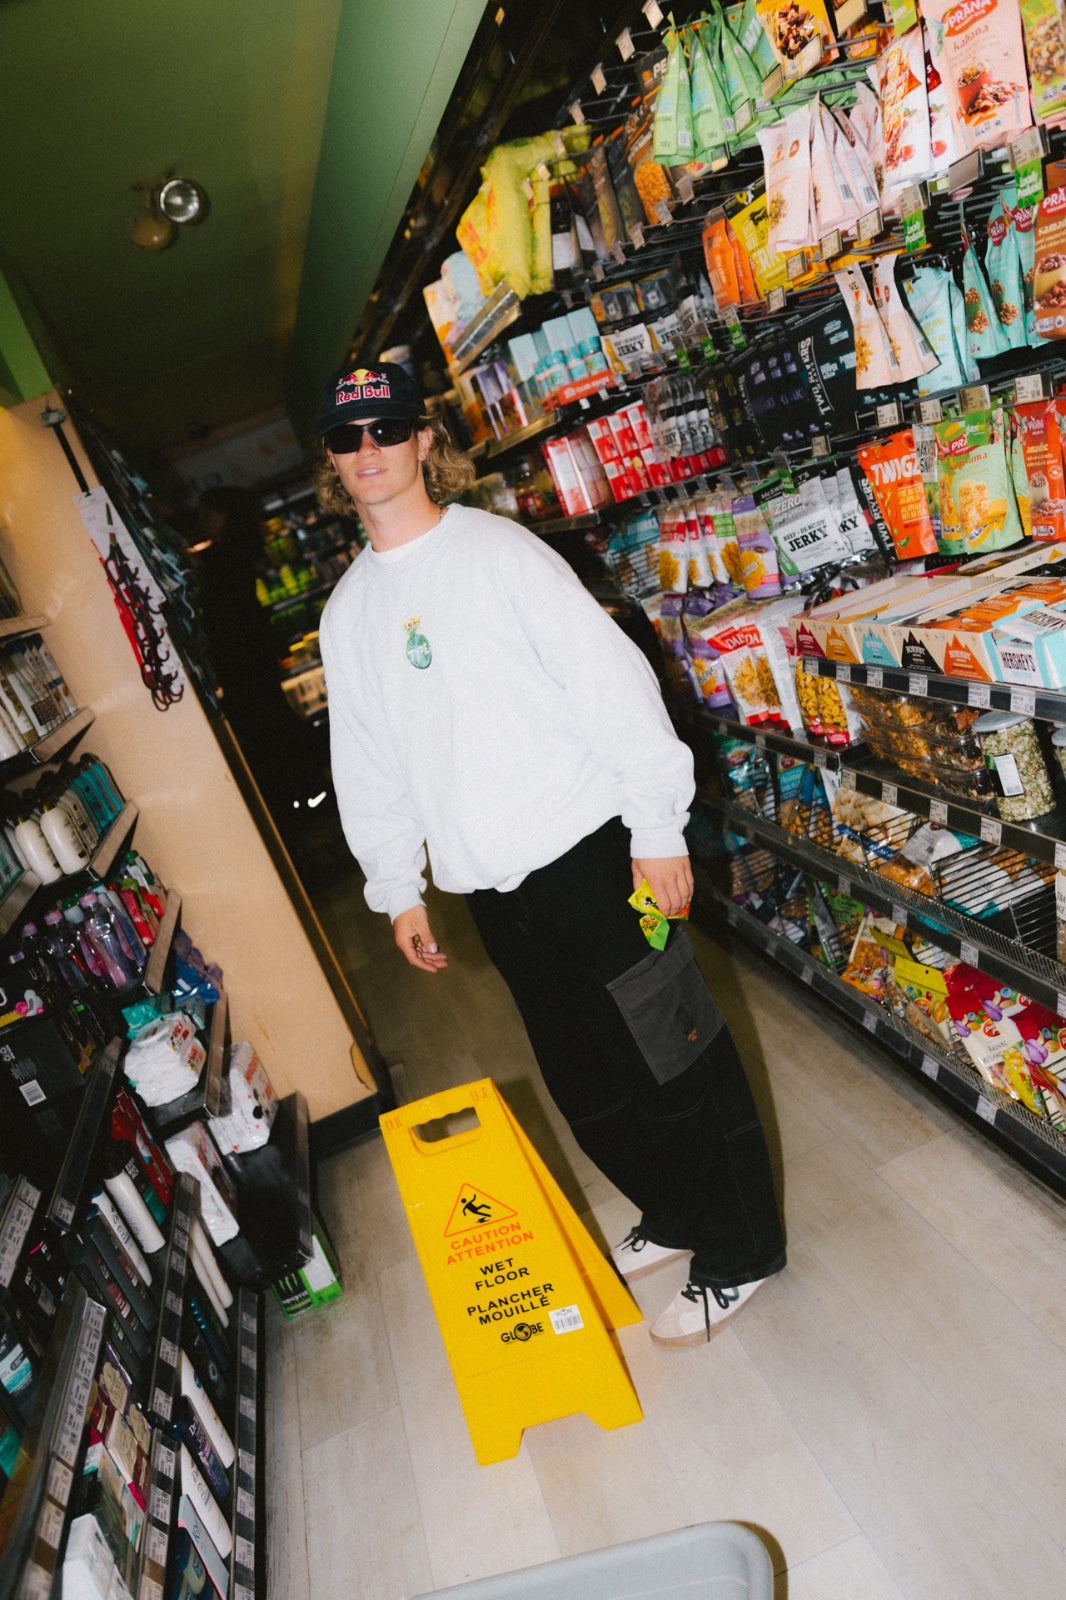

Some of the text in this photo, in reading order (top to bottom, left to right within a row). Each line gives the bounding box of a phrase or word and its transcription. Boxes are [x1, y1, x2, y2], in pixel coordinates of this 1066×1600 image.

[336, 385, 391, 406] Red Bull
[774, 494, 801, 515] ZERO
[788, 525, 829, 552] JERKY
[877, 523, 894, 551] TWO
[1001, 651, 1036, 672] HERSHEY'S
[447, 1231, 534, 1265] ATTENTION
[450, 1221, 522, 1250] CAUTION
[475, 1267, 530, 1291] FLOOR
[480, 1257, 514, 1276] WET
[467, 1283, 555, 1317] PLANCHER
[478, 1295, 550, 1325] MOUILLÉ
